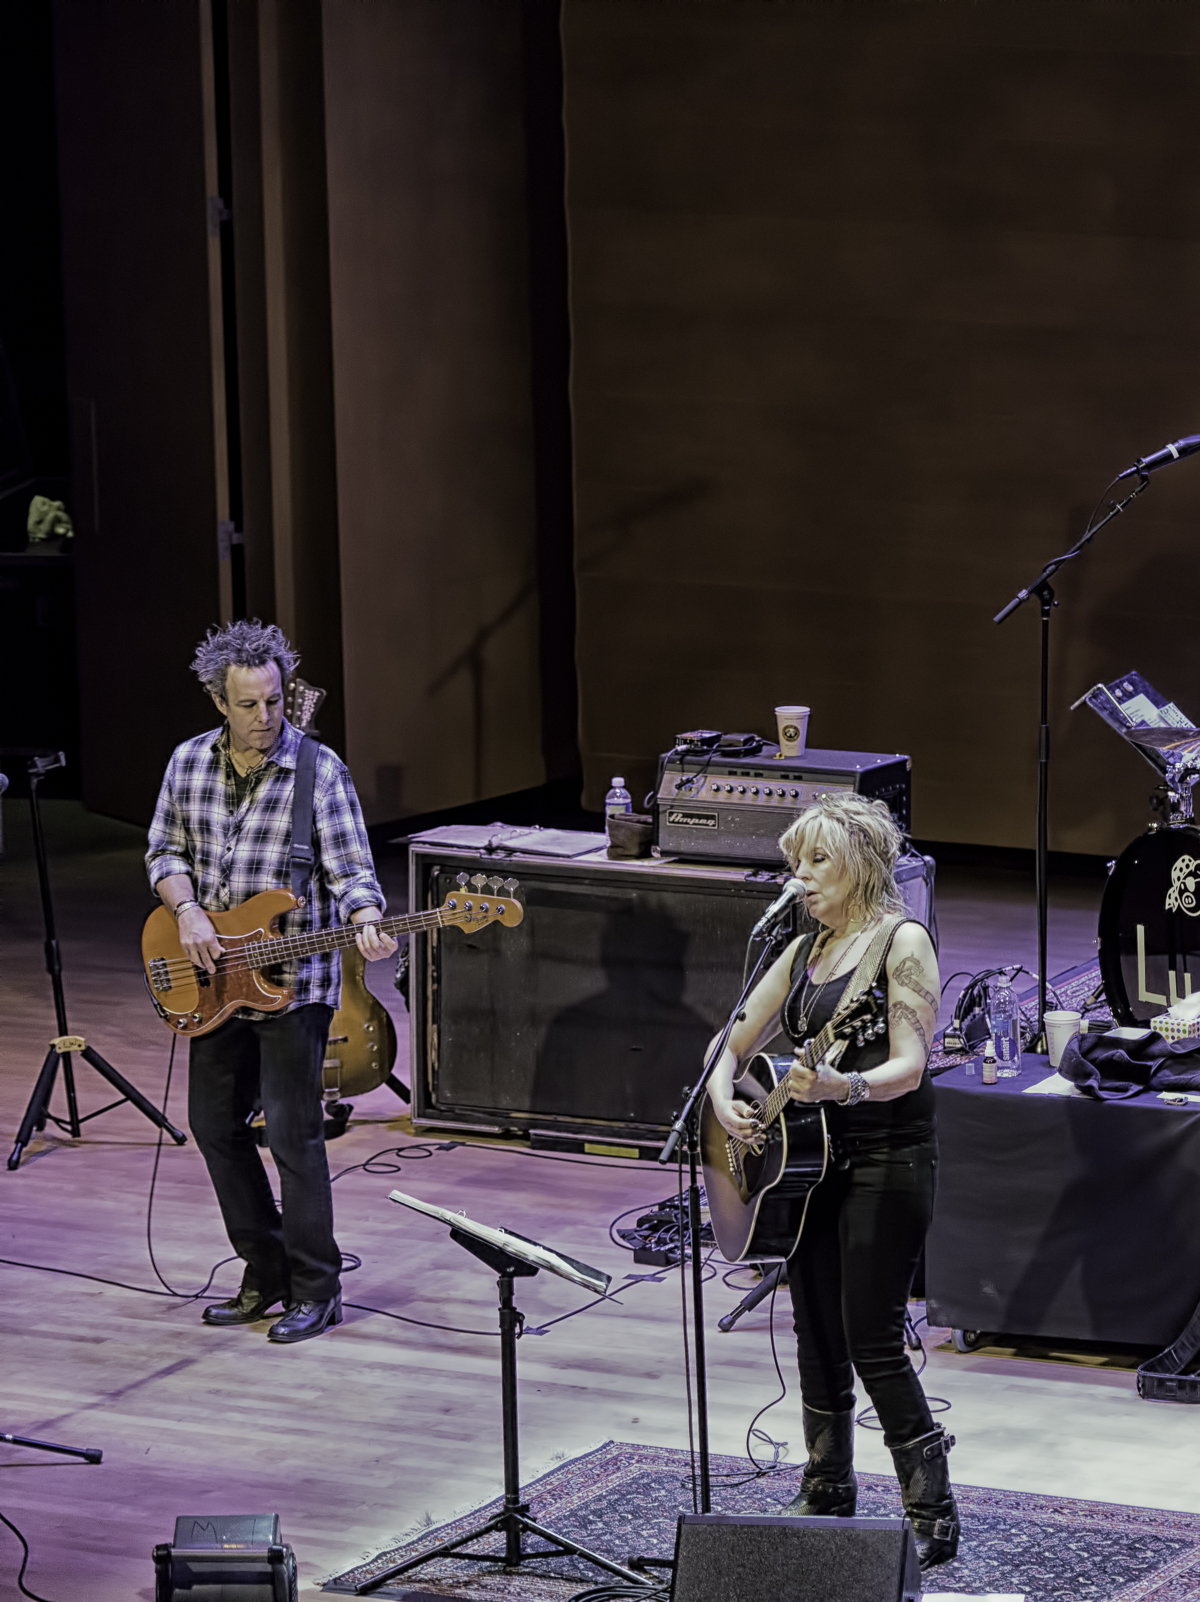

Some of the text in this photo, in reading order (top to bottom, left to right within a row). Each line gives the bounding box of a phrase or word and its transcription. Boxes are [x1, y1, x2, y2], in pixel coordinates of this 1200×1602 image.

[668, 812, 717, 827] Ampeg
[1136, 924, 1192, 1007] Lu
[1001, 1036, 1010, 1061] smart
